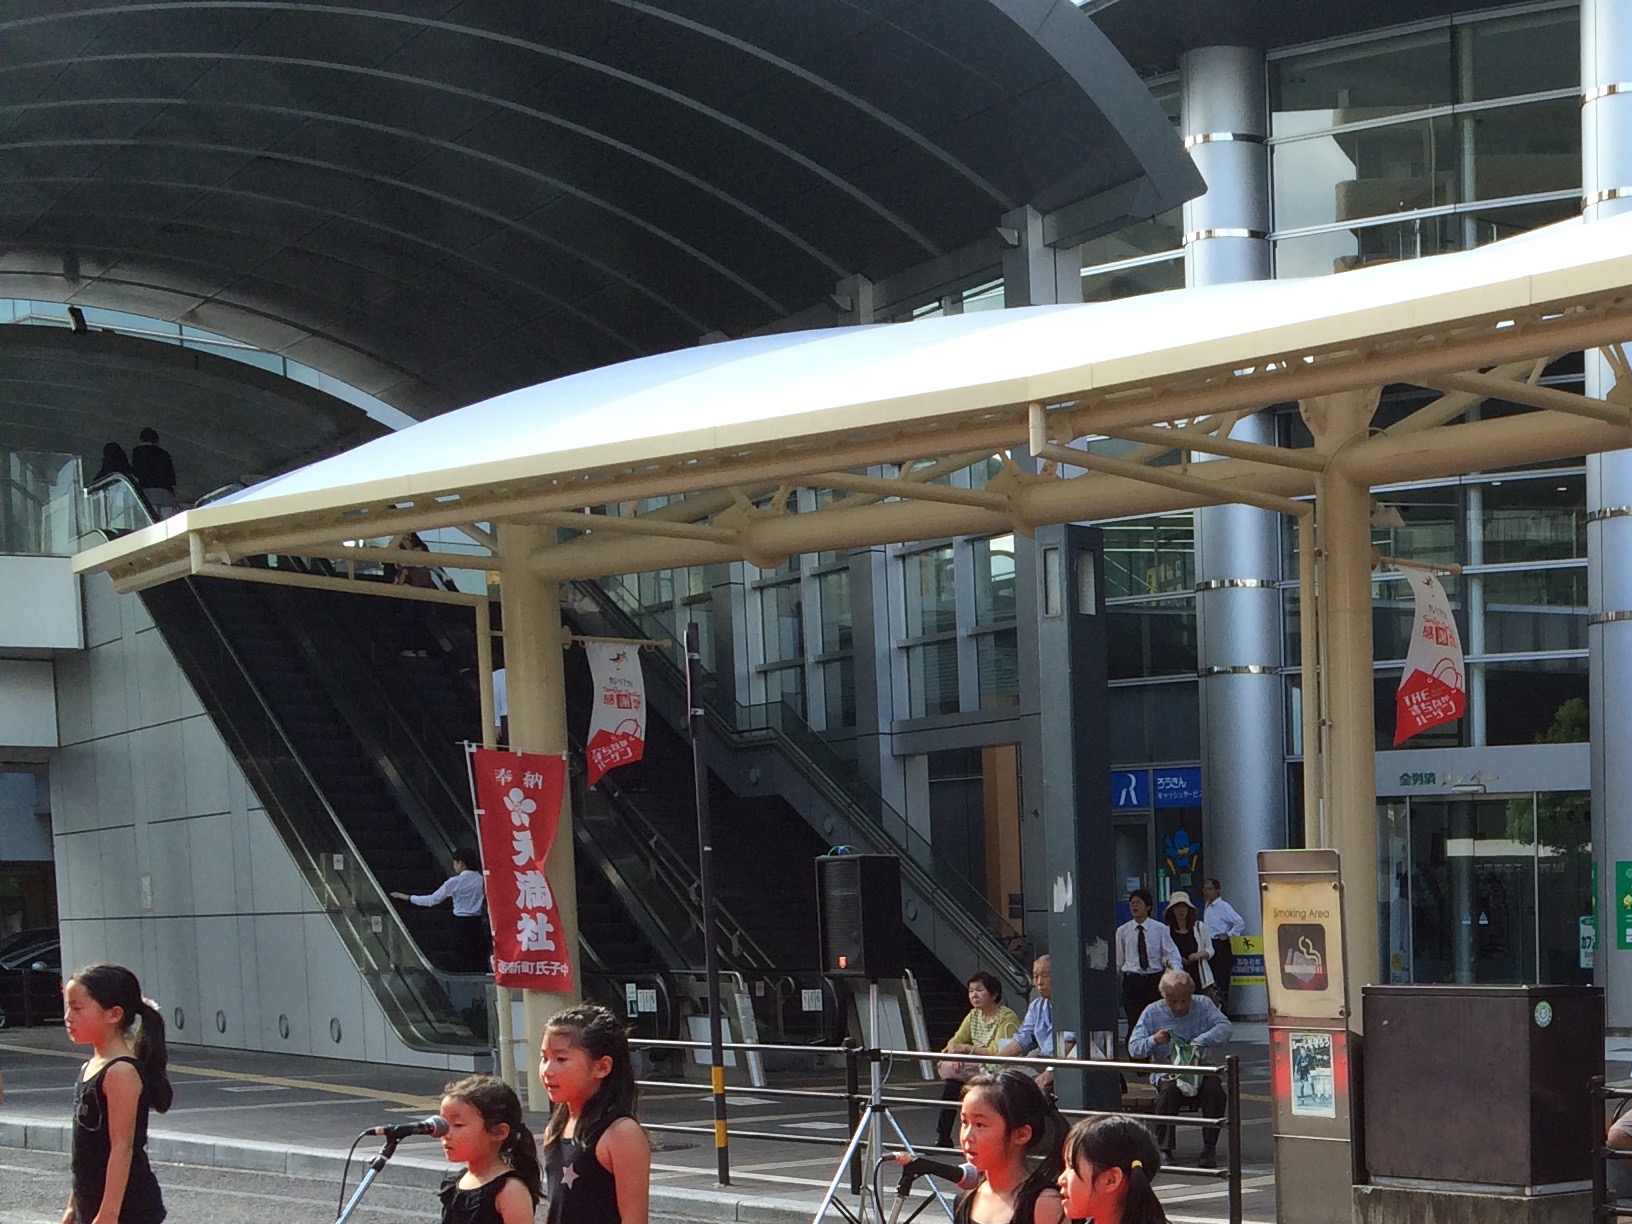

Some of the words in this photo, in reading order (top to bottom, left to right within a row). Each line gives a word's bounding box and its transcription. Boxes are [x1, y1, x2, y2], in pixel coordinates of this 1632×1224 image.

[1403, 688, 1430, 706] THE
[494, 768, 543, 789] 奉納
[1157, 777, 1187, 789] ろうきん
[1273, 908, 1307, 920] Smoking
[1308, 908, 1330, 919] Area
